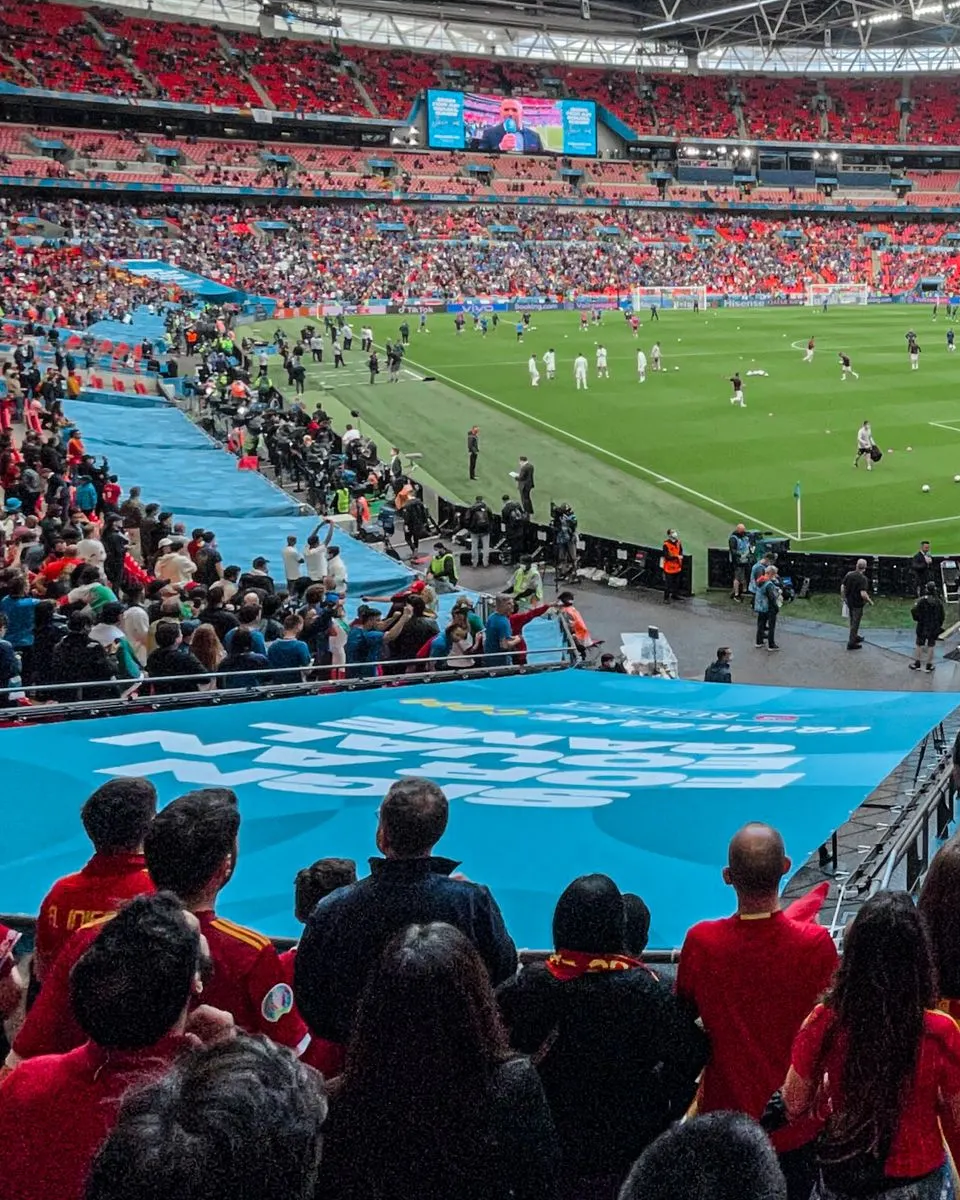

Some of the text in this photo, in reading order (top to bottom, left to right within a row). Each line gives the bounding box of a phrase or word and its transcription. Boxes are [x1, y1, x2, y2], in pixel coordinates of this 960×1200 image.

[462, 304, 494, 312] vivo
[248, 722, 806, 769] EQUAL
[317, 716, 796, 754] GAME
[89, 730, 806, 789] FOR AN
